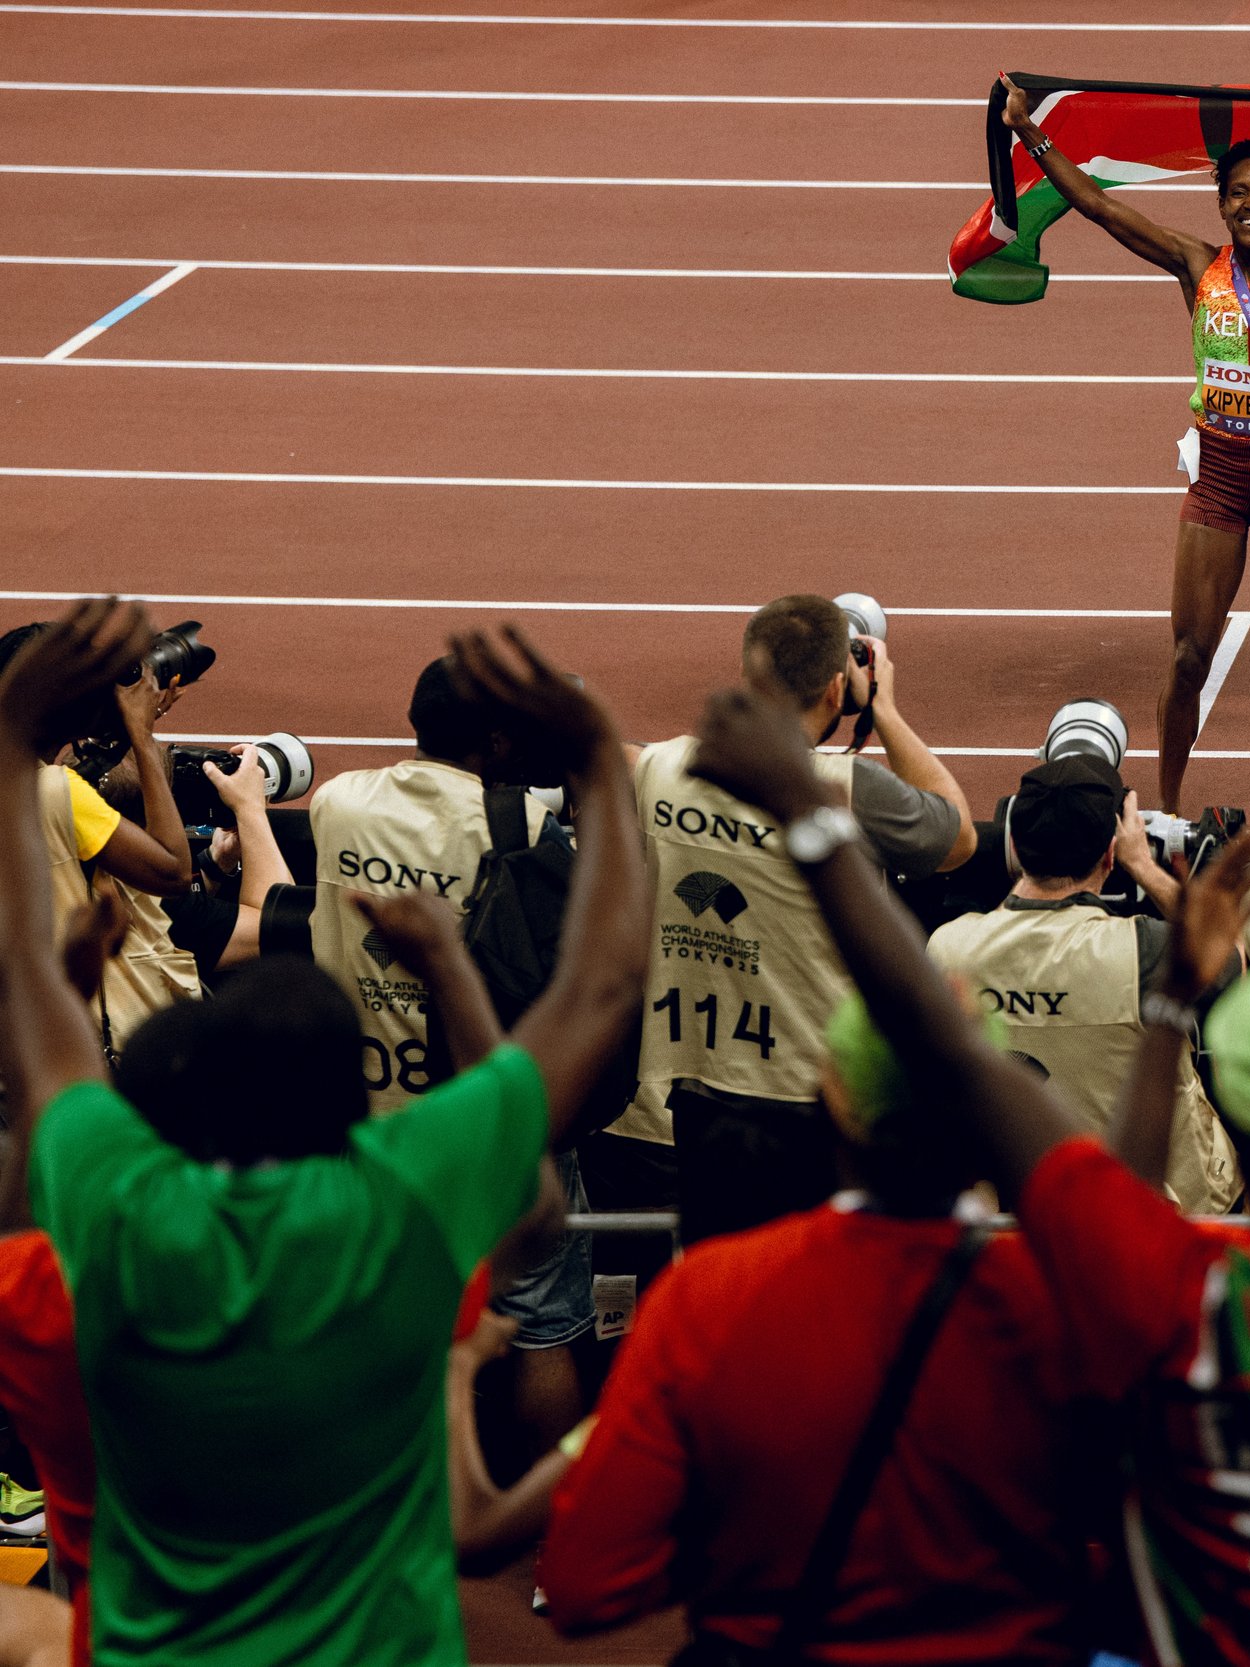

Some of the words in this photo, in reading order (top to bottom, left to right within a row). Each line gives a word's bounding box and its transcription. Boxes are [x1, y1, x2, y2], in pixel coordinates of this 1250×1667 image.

[653, 799, 776, 850] SONY
[338, 850, 462, 899] SONY
[660, 924, 700, 938] WORLD
[703, 931, 760, 951] ATHLETICS
[661, 935, 759, 963] CHAMPIONSHIPS
[653, 987, 776, 1060] 114
[361, 1036, 431, 1094] 08
[603, 1311, 625, 1326] AP
